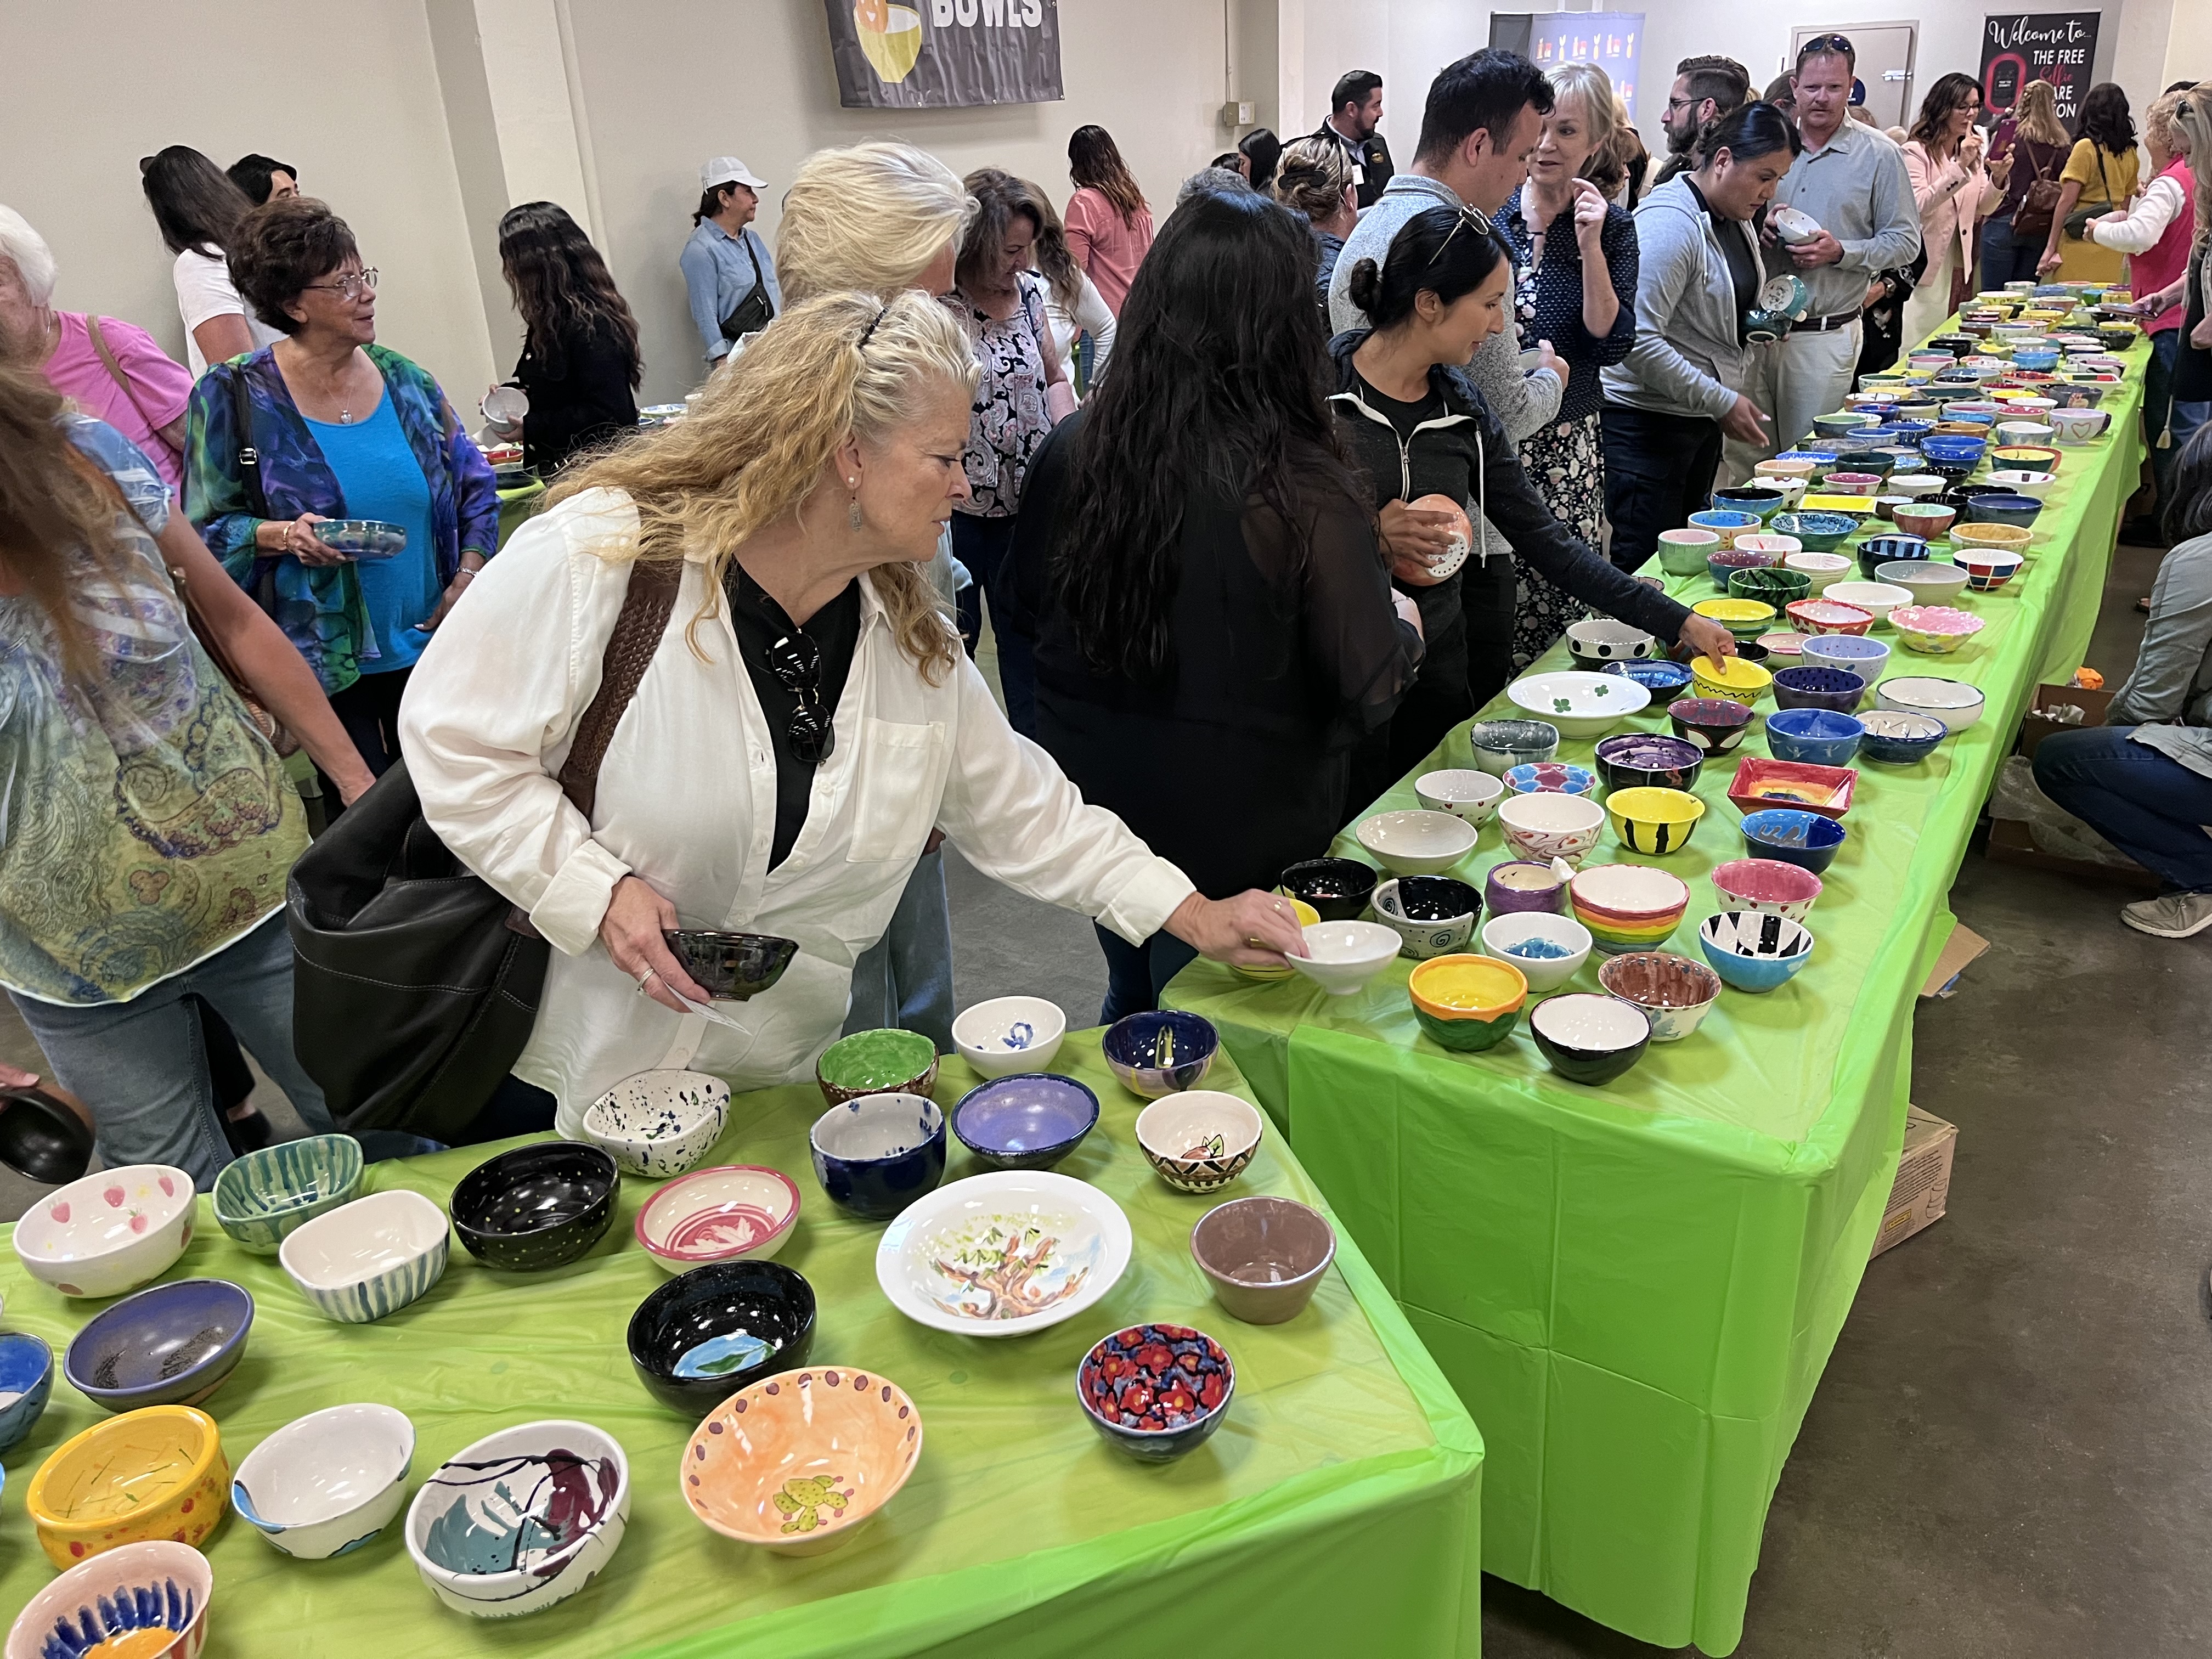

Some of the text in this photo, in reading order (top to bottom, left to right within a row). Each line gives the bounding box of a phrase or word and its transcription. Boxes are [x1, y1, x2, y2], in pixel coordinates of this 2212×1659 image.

[1988, 16, 2065, 49] Welcome
[2033, 49, 2085, 65] THE FREE
